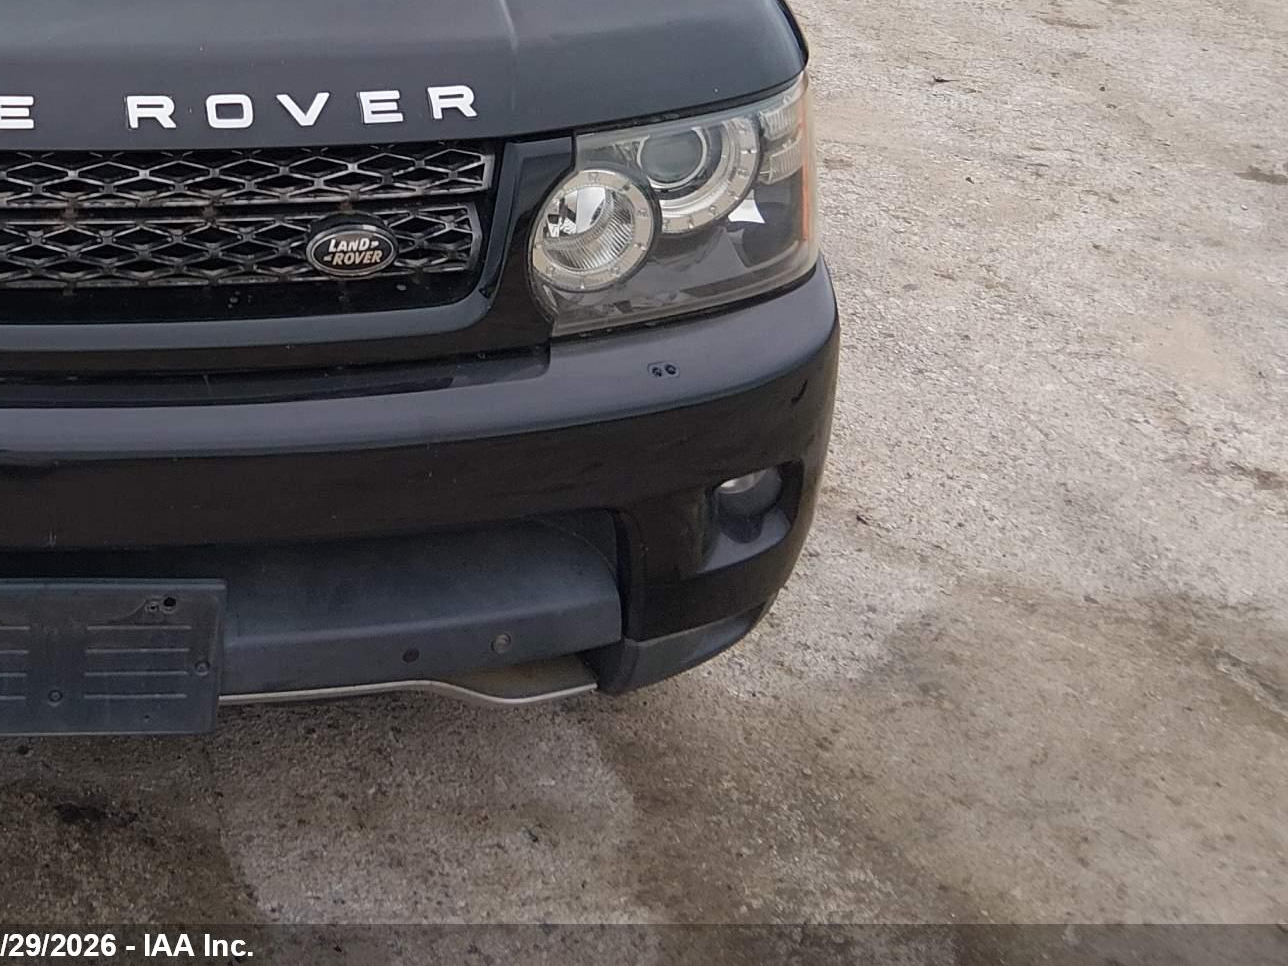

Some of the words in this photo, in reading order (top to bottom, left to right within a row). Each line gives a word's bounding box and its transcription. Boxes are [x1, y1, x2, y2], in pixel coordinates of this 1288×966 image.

[126, 85, 478, 129] ROVER
[328, 237, 370, 253] LAND
[332, 249, 383, 266] ROVER
